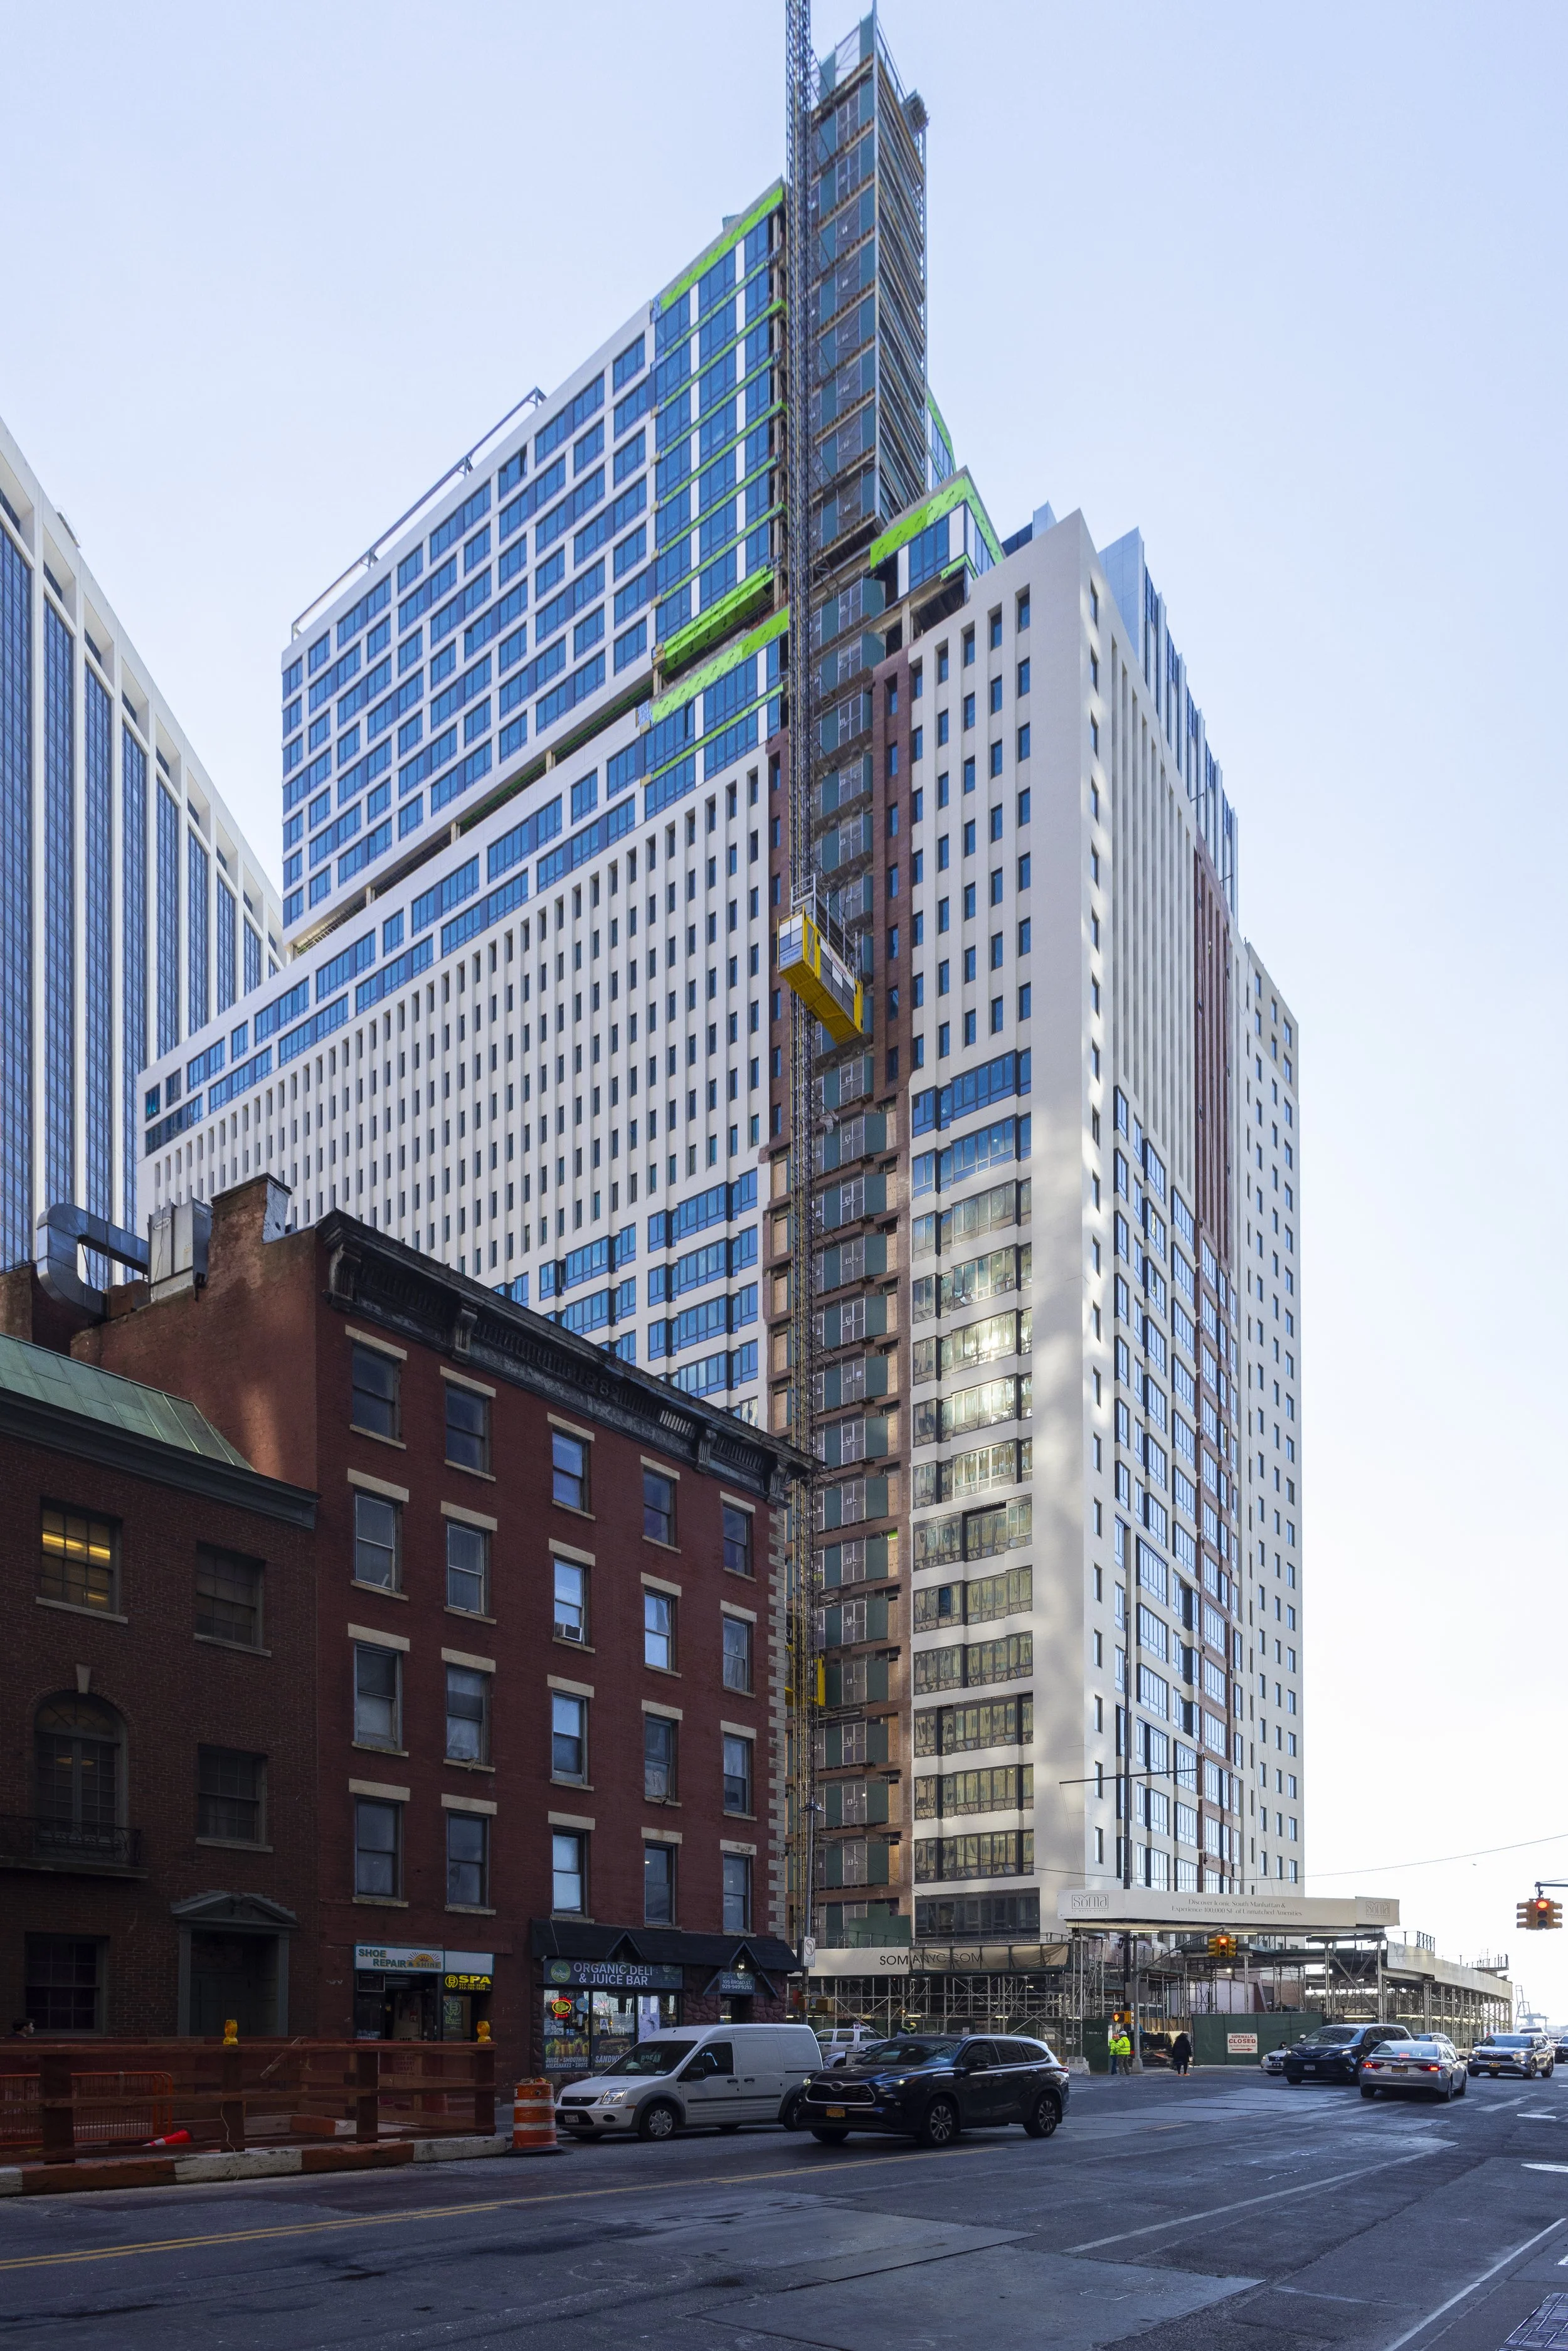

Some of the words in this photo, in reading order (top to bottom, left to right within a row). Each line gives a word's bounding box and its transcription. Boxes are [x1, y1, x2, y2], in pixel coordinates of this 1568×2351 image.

[358, 1948, 387, 1958] SHOE
[373, 1958, 406, 1968] REPAIR
[879, 1953, 983, 1966] SOMANYCCOM
[573, 1962, 627, 1975] ORGANIC
[630, 1965, 653, 1976] DELI
[458, 1975, 492, 1985] SPA
[578, 1973, 587, 1983] &
[590, 1973, 623, 1985] JUICE
[626, 1975, 648, 1986] BAR
[601, 2019, 607, 2028] A
